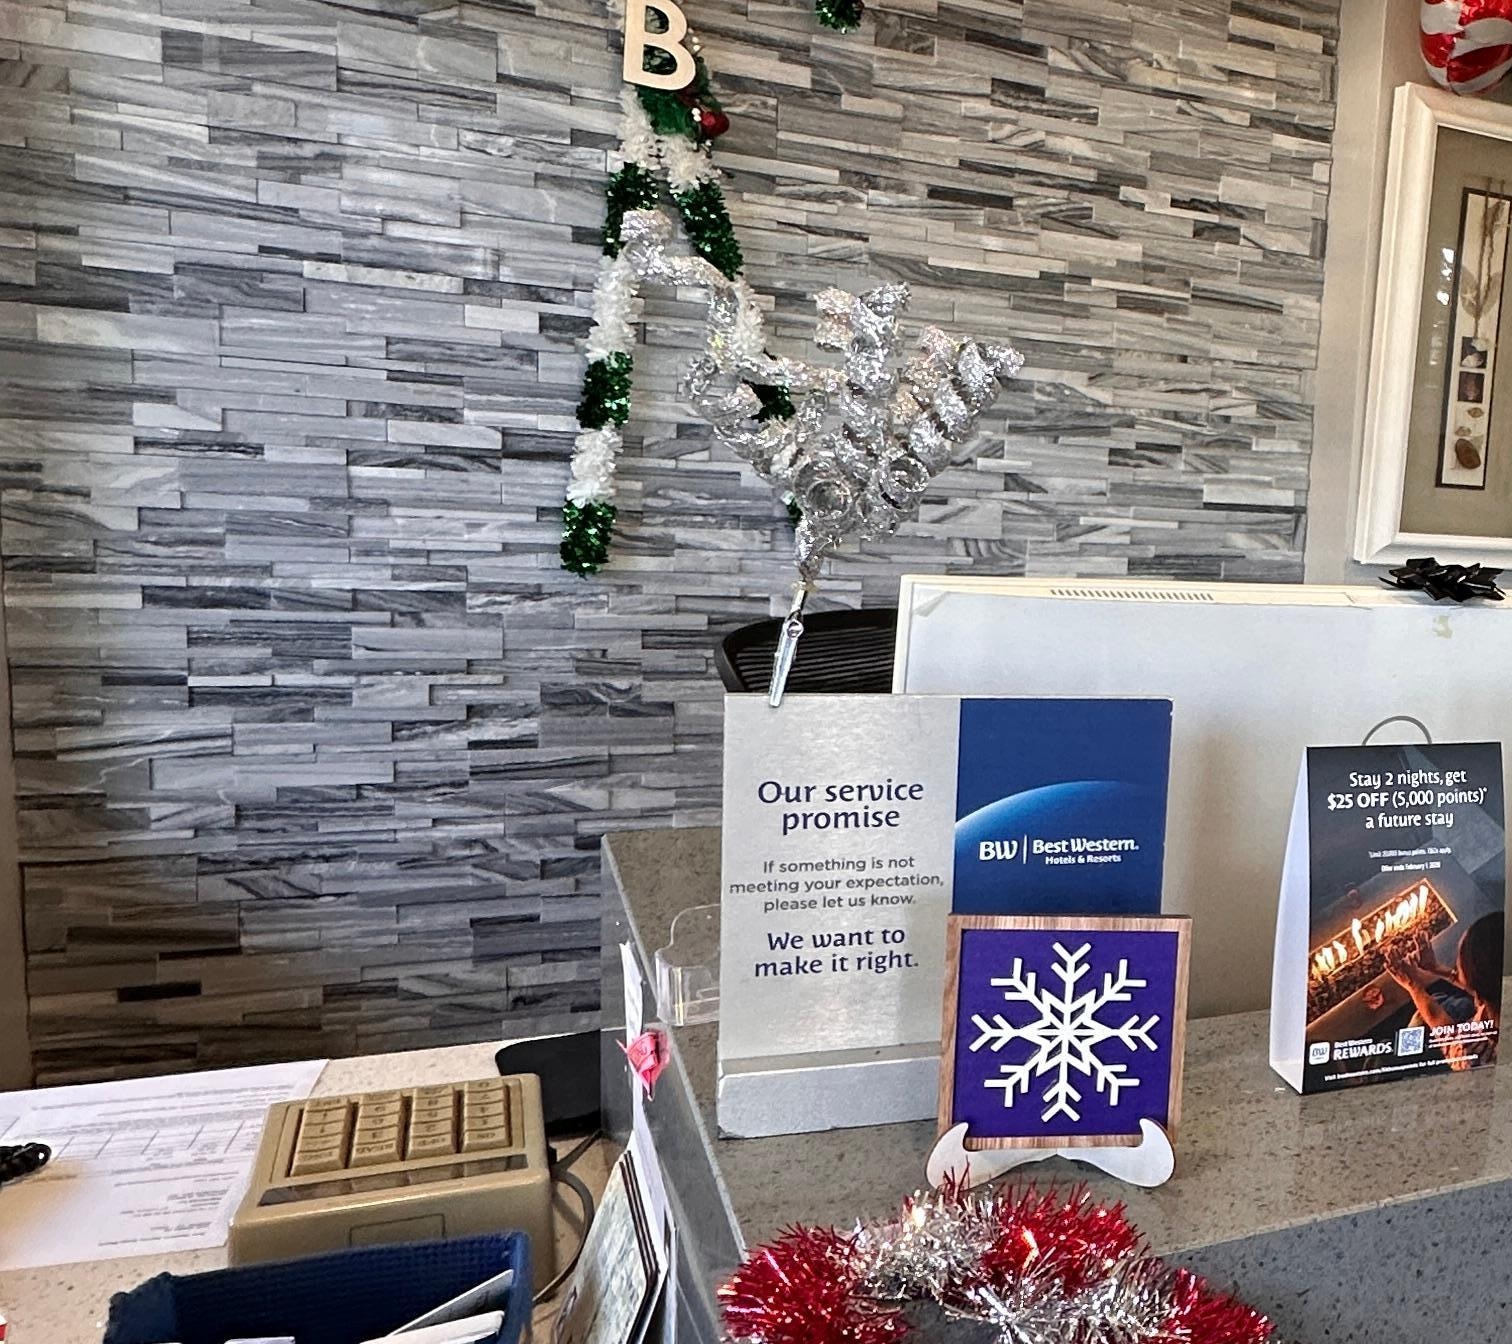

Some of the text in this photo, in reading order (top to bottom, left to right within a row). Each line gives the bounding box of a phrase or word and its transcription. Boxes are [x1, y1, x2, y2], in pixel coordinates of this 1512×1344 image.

[1348, 769, 1467, 789] Stay 2 nights, get
[757, 779, 924, 805] Our service
[1327, 792, 1354, 811] $25
[1357, 791, 1389, 808] OFF
[1392, 790, 1434, 809] (5,000
[781, 805, 901, 836] promise
[1365, 811, 1454, 830] a future stay
[979, 840, 1018, 861] BW
[1032, 837, 1069, 855] Best
[1045, 854, 1122, 865] Hotels & Resorts
[763, 855, 916, 878] If something is not
[729, 872, 945, 898] meeting your expectation,
[763, 892, 917, 914] please let us know.
[767, 928, 906, 952] We want to
[754, 950, 920, 978] make it right.
[1429, 1019, 1494, 1037] JOIN TODAY!
[1333, 1042, 1392, 1061] REWARDS
